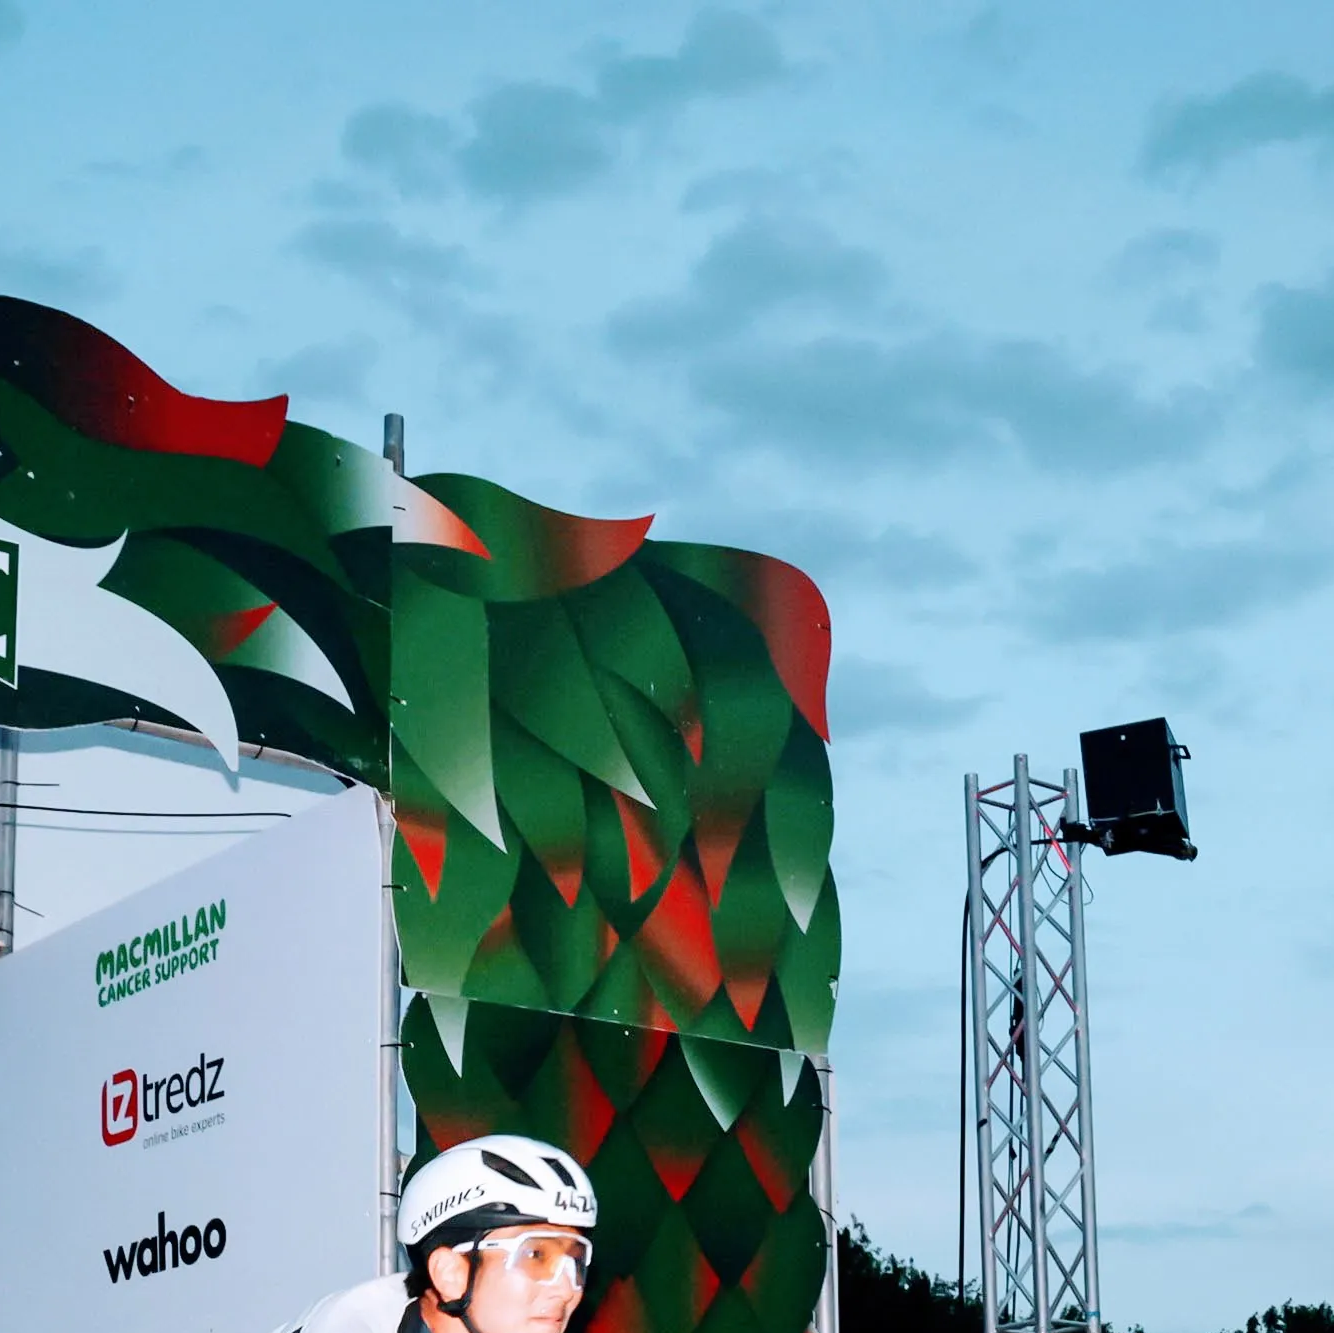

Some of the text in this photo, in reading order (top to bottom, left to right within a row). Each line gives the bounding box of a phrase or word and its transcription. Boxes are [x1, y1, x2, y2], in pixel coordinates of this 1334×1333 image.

[96, 899, 226, 985] MACMILLAN
[98, 938, 219, 1007] CANCER SUPPORT
[143, 1053, 224, 1122] tredz
[143, 1112, 226, 1150] online bike experts
[411, 1183, 488, 1238] S-WORKS
[103, 1211, 227, 1284] wahoo
